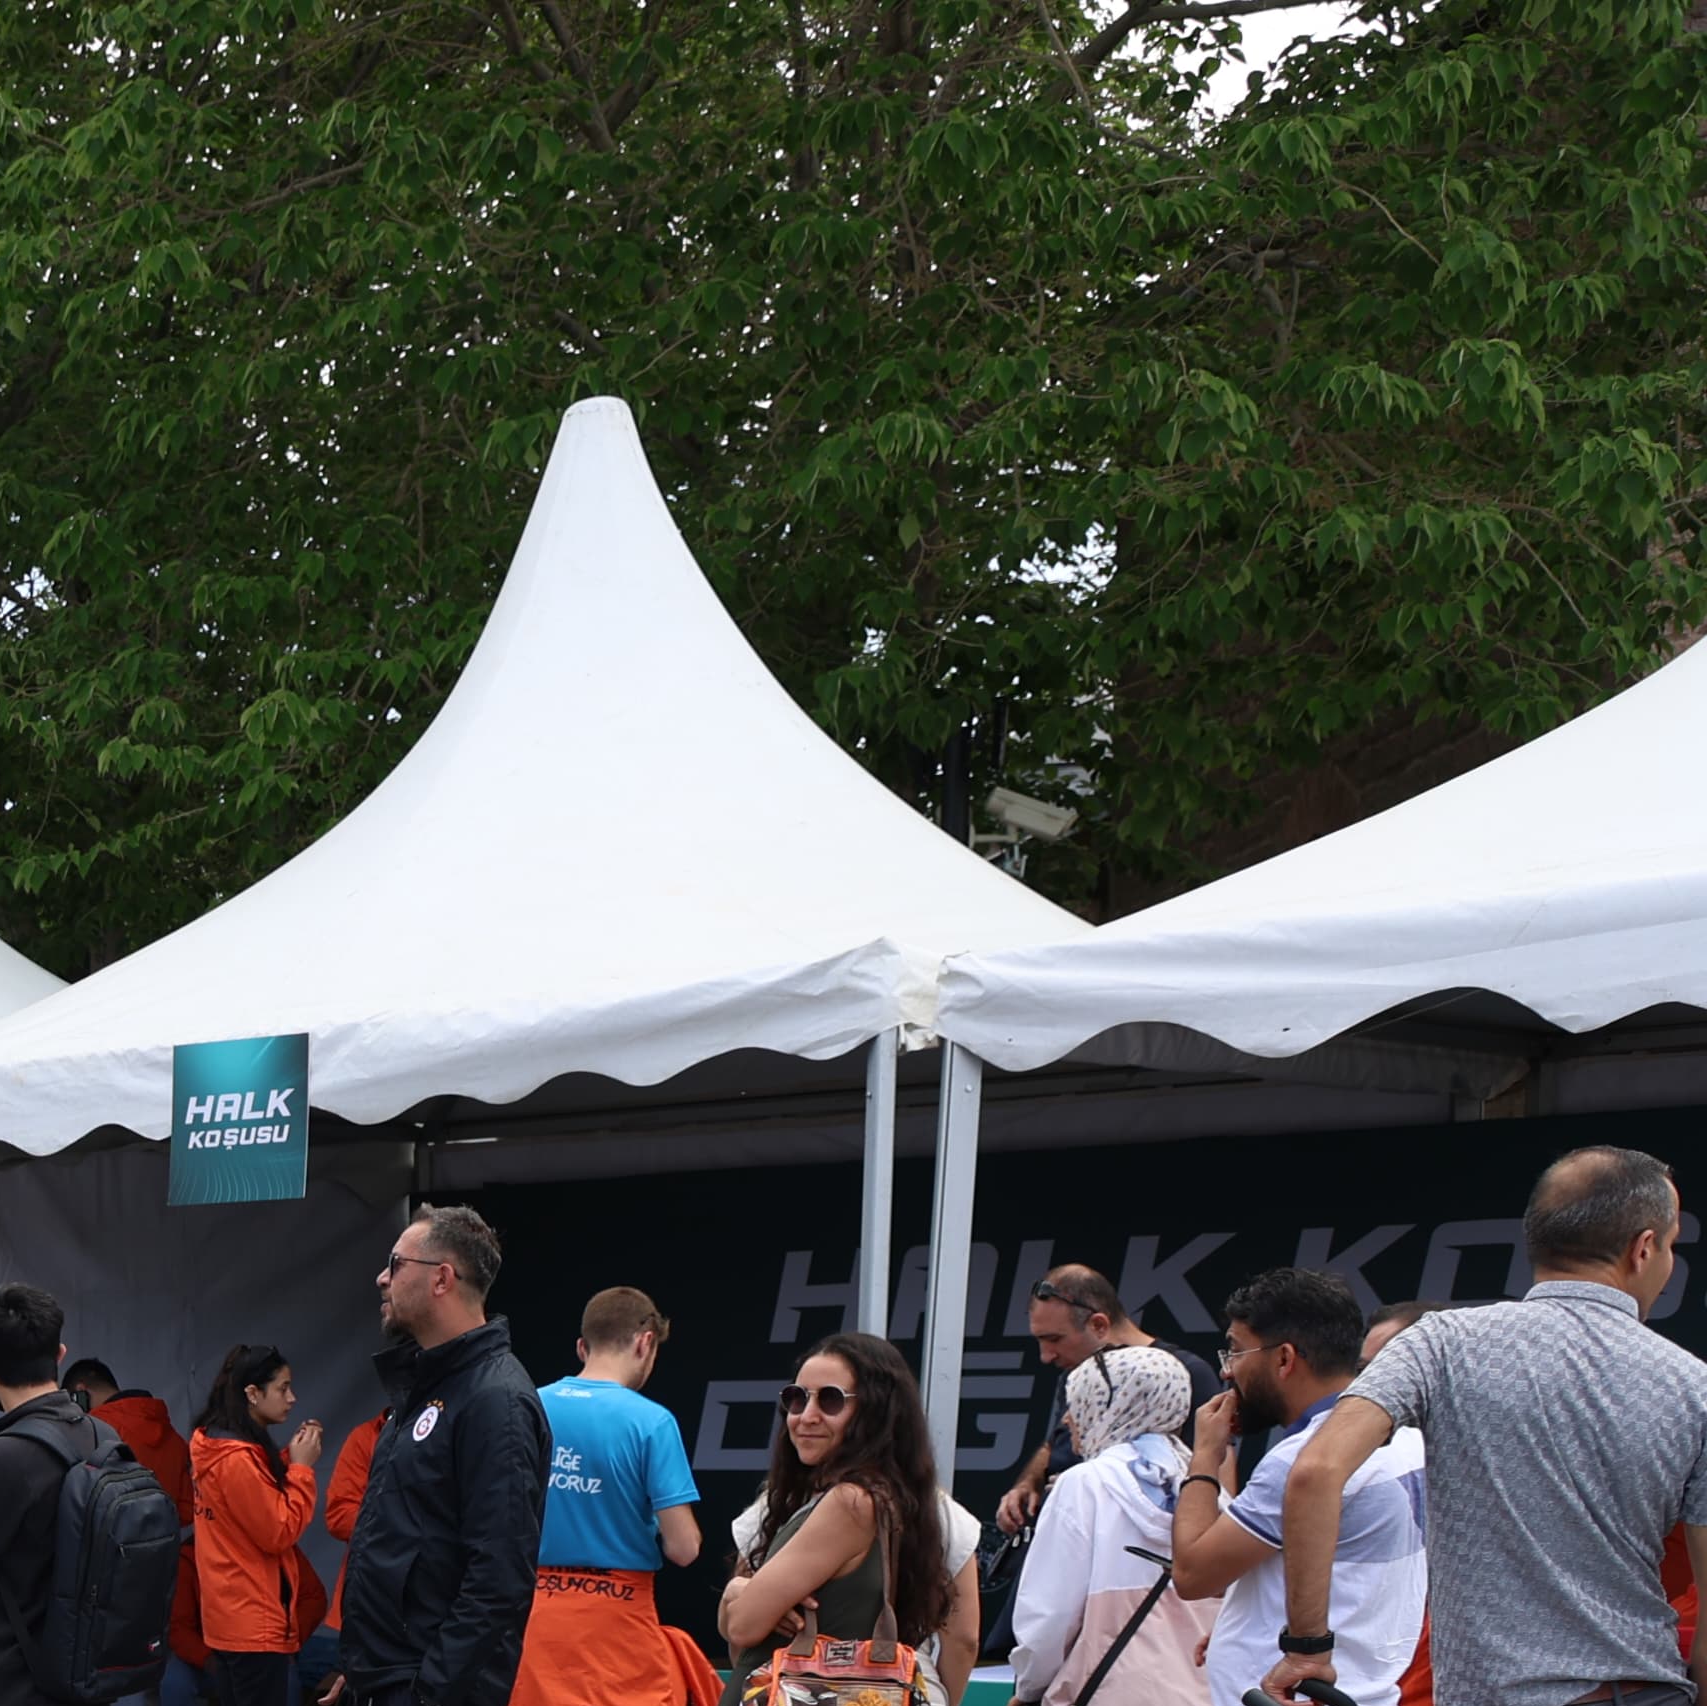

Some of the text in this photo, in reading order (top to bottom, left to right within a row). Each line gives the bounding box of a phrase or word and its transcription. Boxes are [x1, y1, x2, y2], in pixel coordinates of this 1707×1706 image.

[185, 1088, 295, 1125] HALK
[188, 1124, 290, 1150] KOŞUSU
[536, 1574, 635, 1601] OŞUYORUZ
